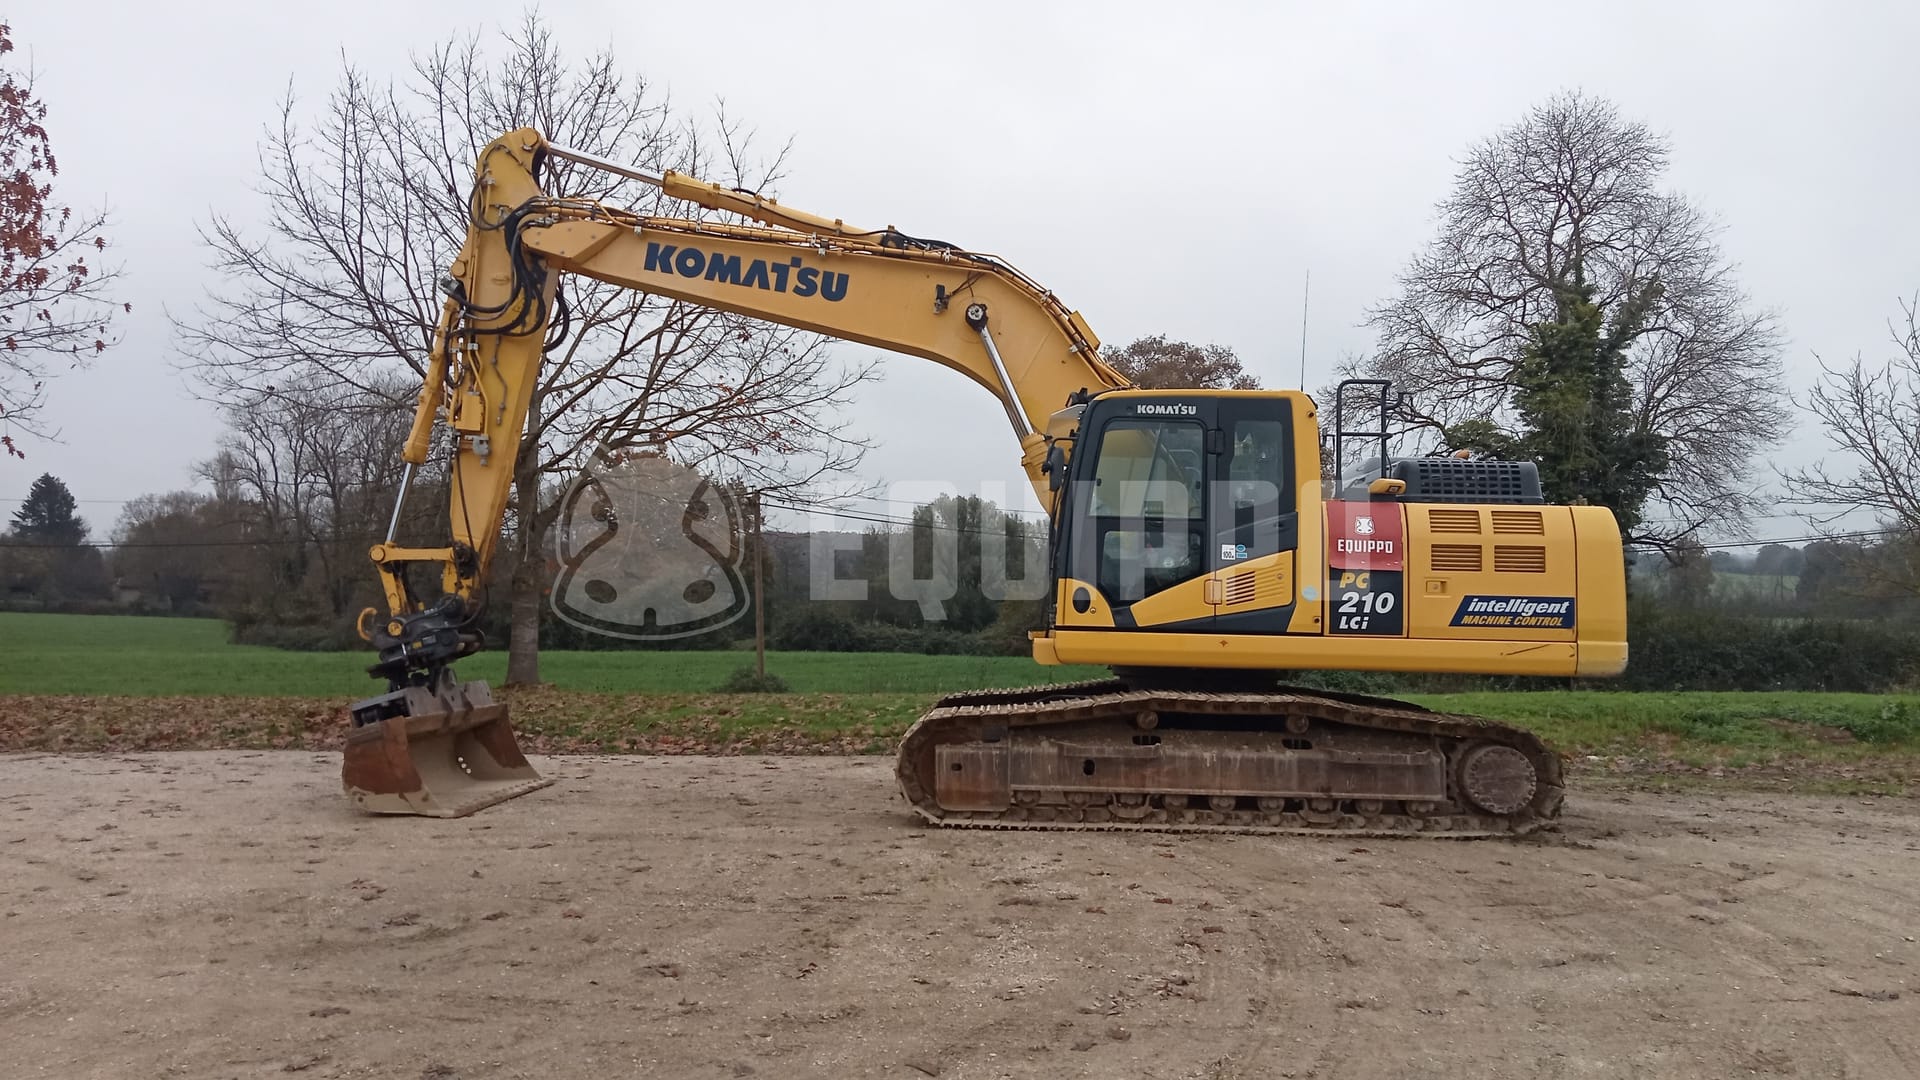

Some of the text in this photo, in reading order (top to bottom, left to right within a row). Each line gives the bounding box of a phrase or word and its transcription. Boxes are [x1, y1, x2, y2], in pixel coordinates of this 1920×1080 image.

[643, 241, 850, 302] KOMATSU
[1137, 402, 1197, 415] KOMATSU
[1337, 539, 1394, 554] EQUIPPO
[1339, 572, 1370, 589] PC
[1338, 591, 1395, 614] 210
[1467, 598, 1570, 617] intelligent
[1339, 615, 1369, 630] LCi
[1460, 615, 1563, 626] MACHINE CONTROL
